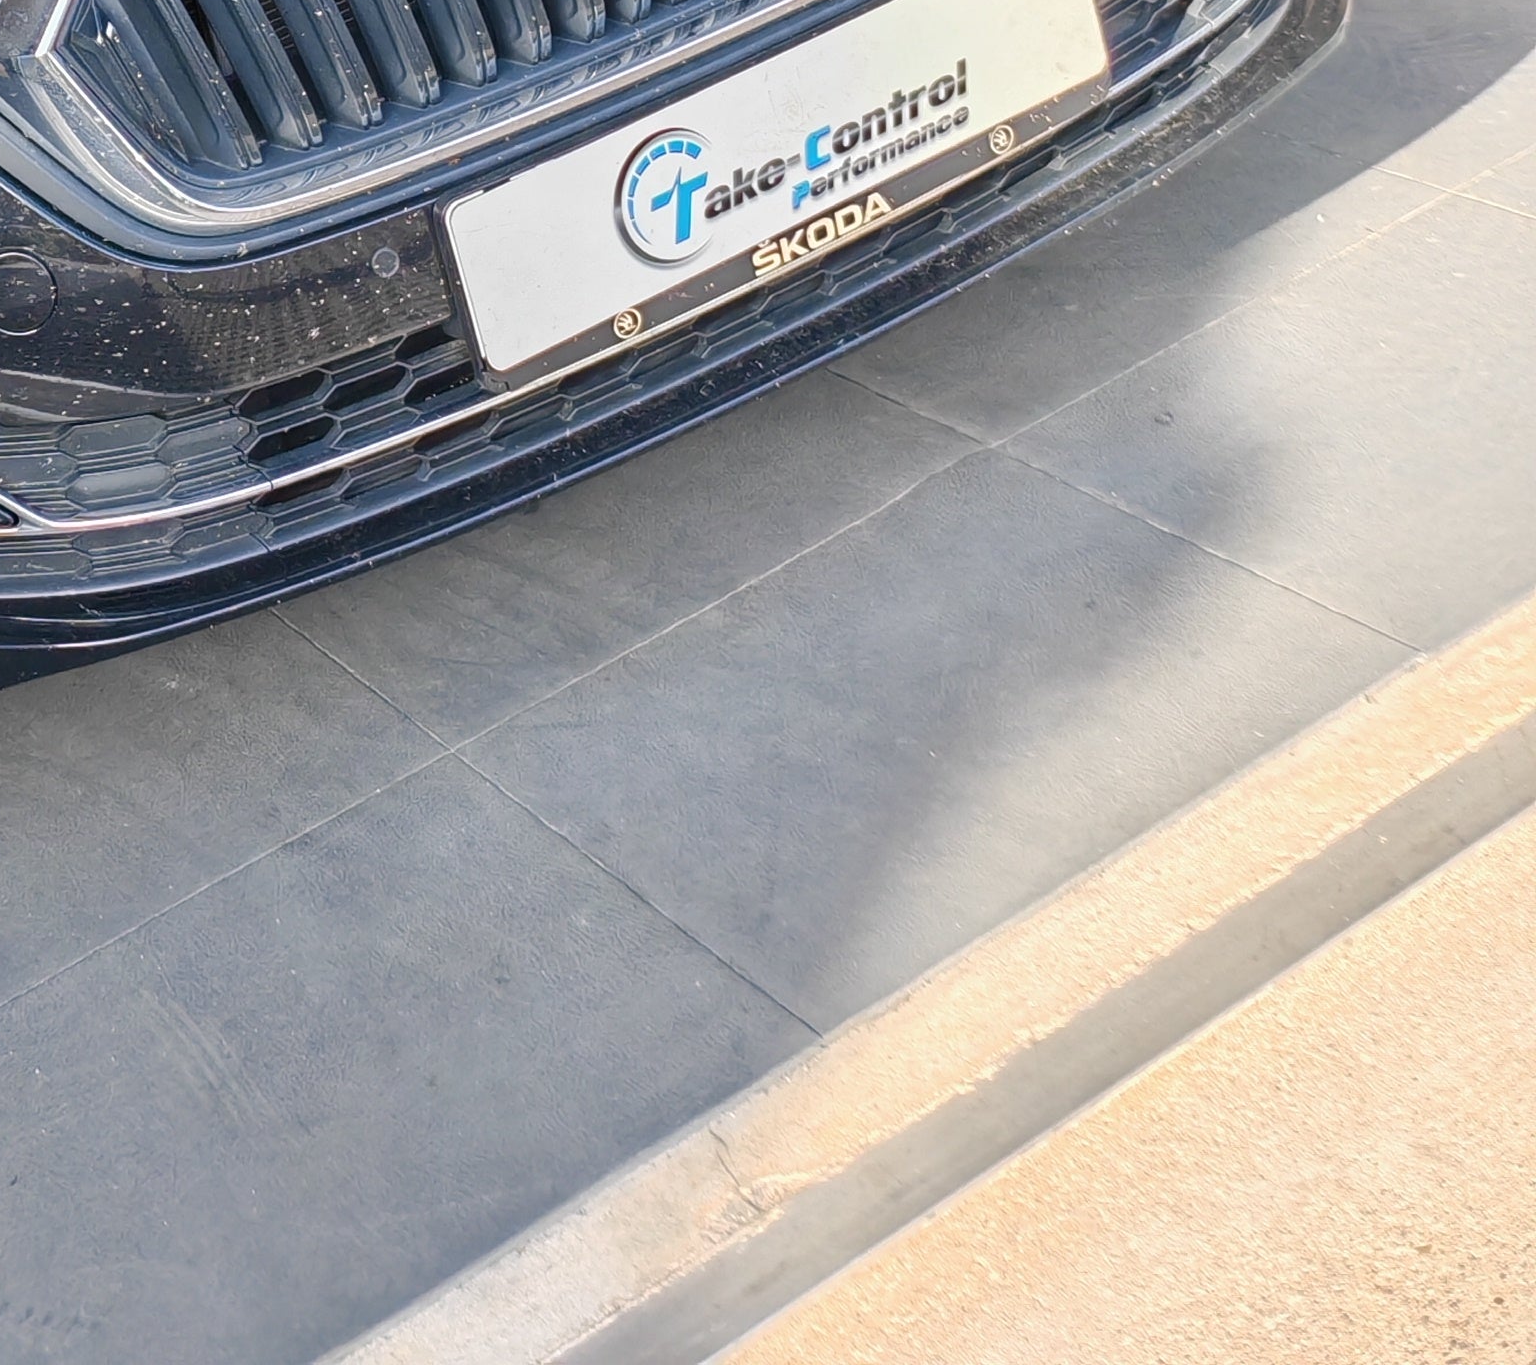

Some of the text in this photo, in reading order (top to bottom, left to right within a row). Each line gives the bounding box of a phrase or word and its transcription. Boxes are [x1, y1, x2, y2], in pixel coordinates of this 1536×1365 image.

[650, 57, 968, 245] Take-Control
[791, 106, 970, 211] Performance
[751, 191, 893, 278] ŠKODA
